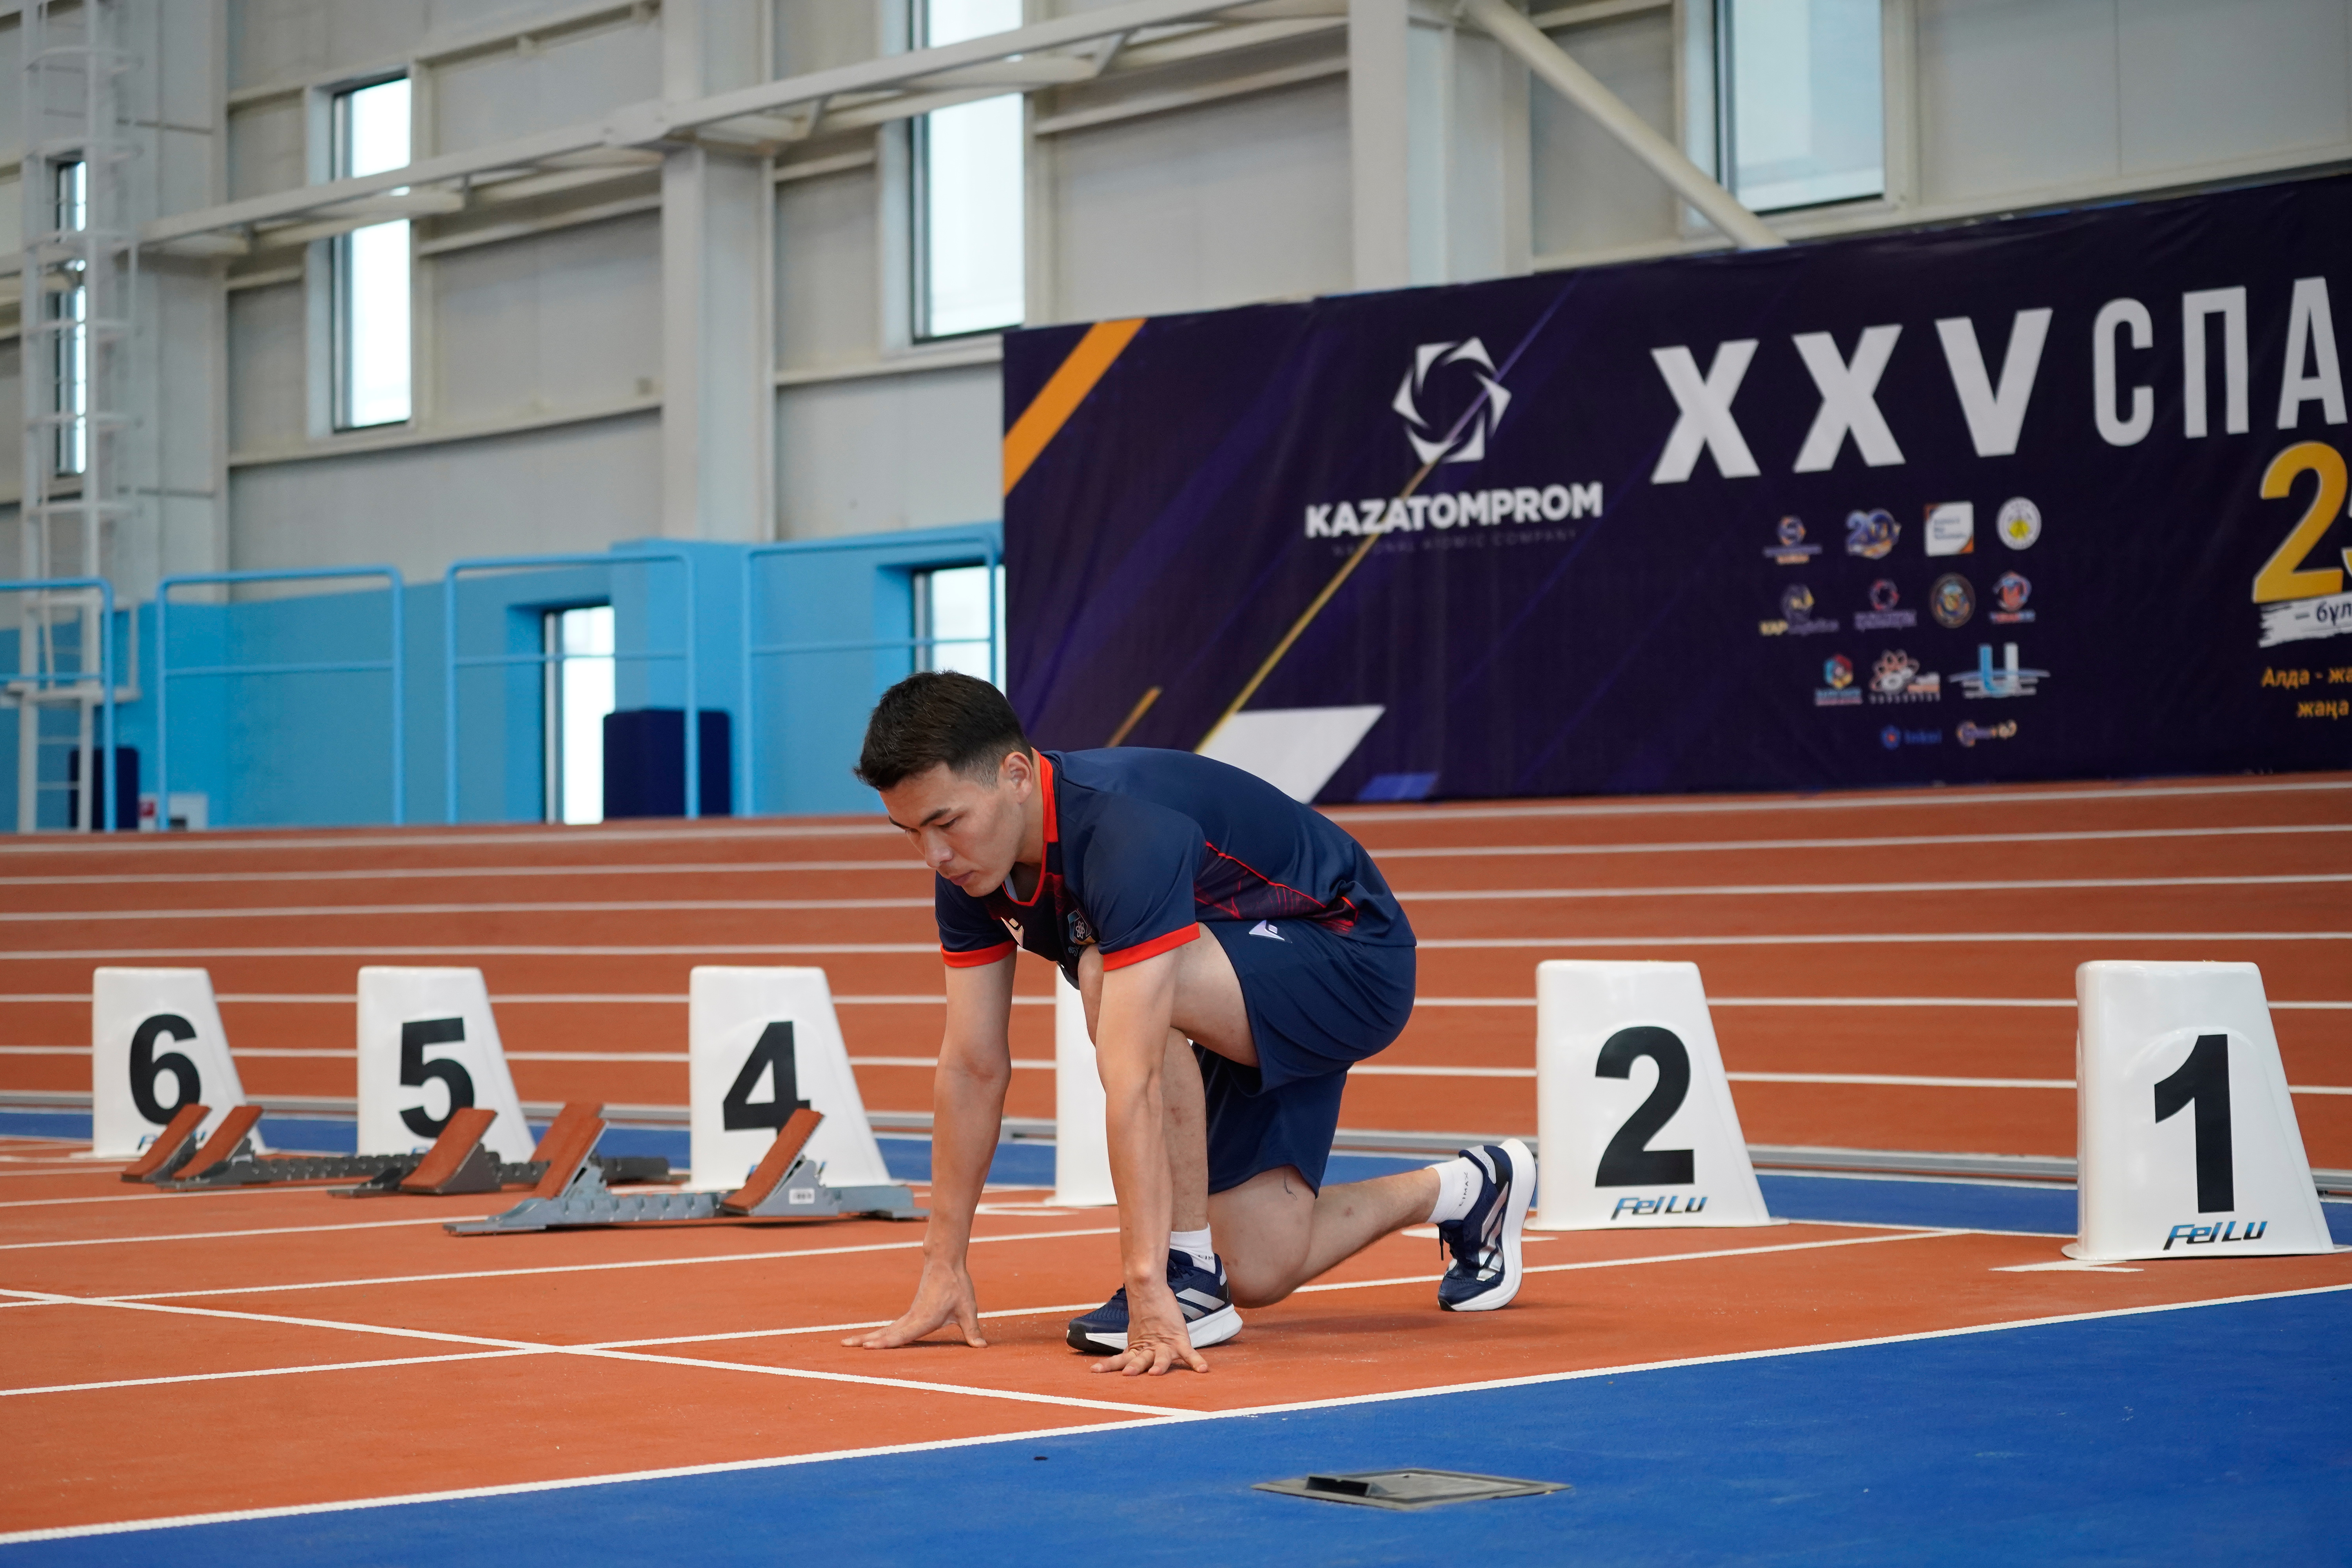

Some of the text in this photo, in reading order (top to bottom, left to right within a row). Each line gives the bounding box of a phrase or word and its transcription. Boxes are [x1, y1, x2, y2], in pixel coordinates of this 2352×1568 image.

[2092, 276, 2348, 446] СПА
[1305, 481, 1603, 538] KAZATOMPROM
[2252, 442, 2352, 604] 2
[2261, 667, 2310, 689] Алда
[2297, 700, 2349, 720] жаңа
[129, 1013, 201, 1125] 6
[399, 1016, 474, 1138] 5
[722, 1020, 811, 1136] 4
[1595, 1026, 1695, 1187] 2
[2154, 1034, 2235, 1214] 1
